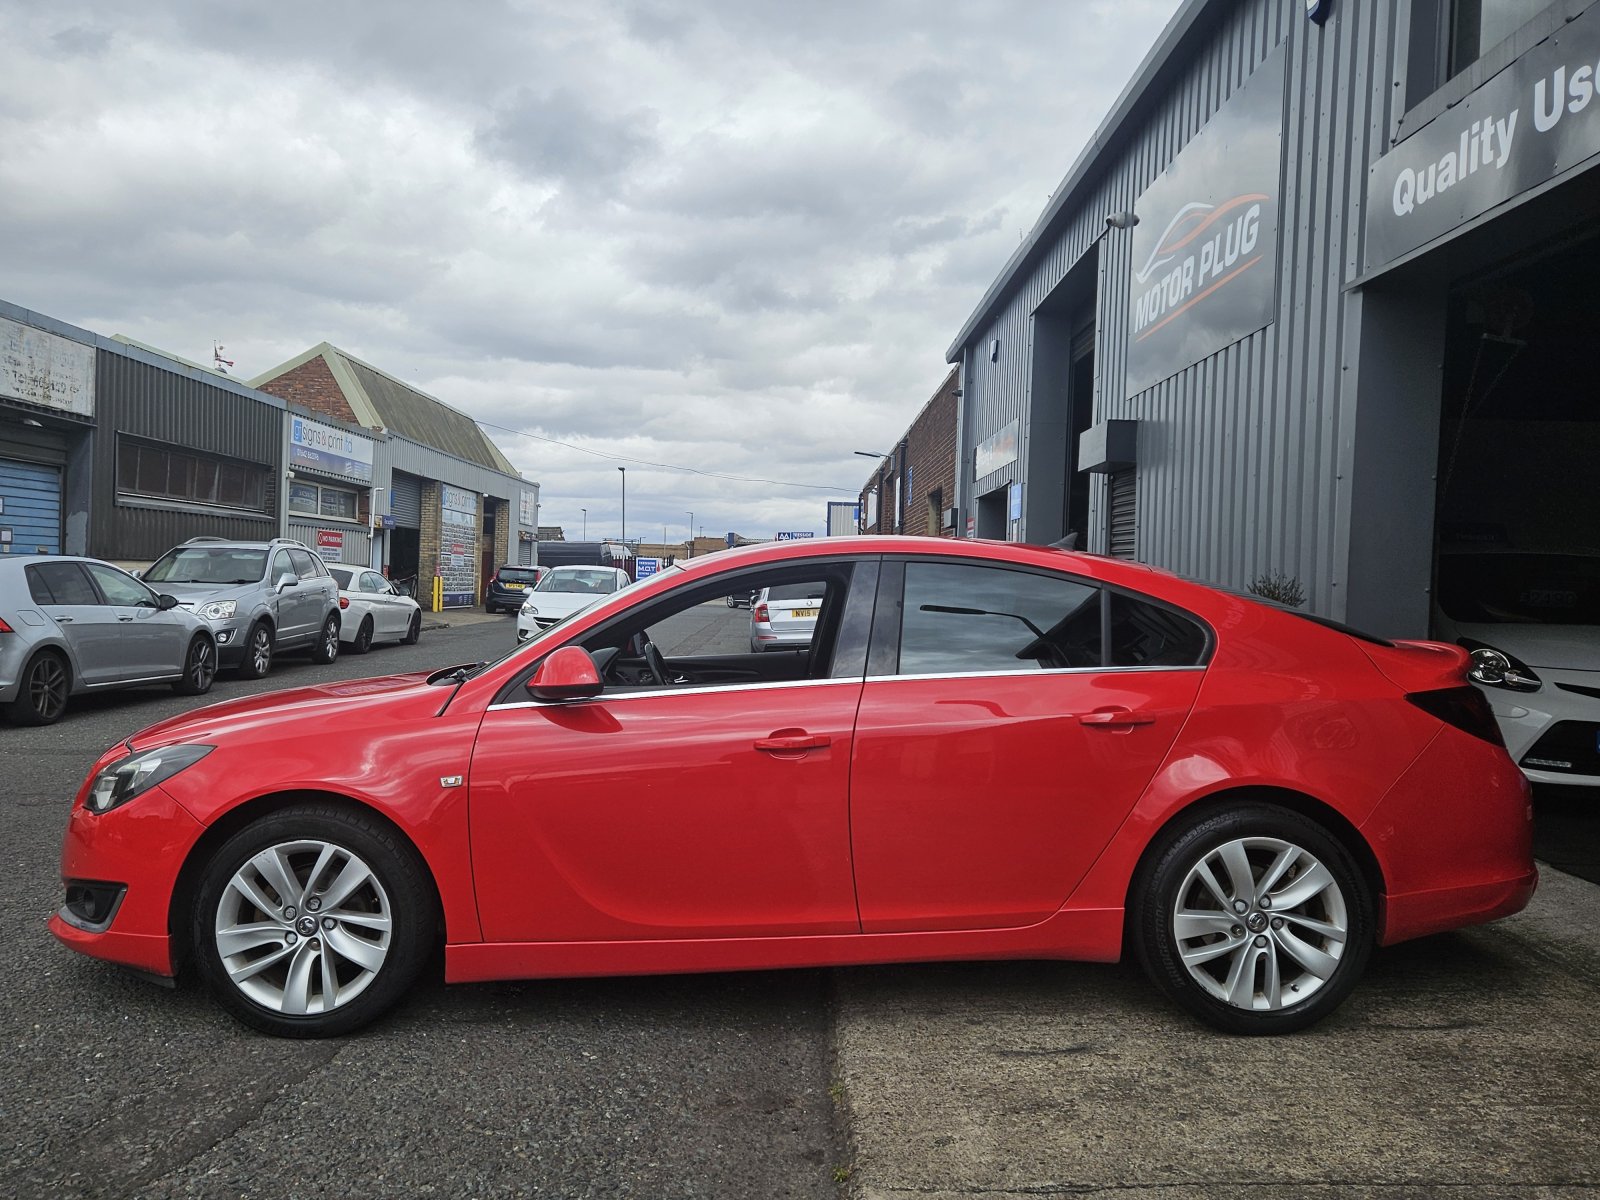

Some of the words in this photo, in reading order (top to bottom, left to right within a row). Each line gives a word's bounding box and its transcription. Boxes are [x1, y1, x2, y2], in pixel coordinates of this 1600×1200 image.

[1393, 109, 1519, 216] Quality
[1534, 57, 1600, 132] Us
[1135, 255, 1195, 333] MOTOR
[1198, 204, 1260, 287] PLUG
[303, 424, 320, 446] signs
[321, 430, 327, 446] &
[328, 433, 343, 450] print
